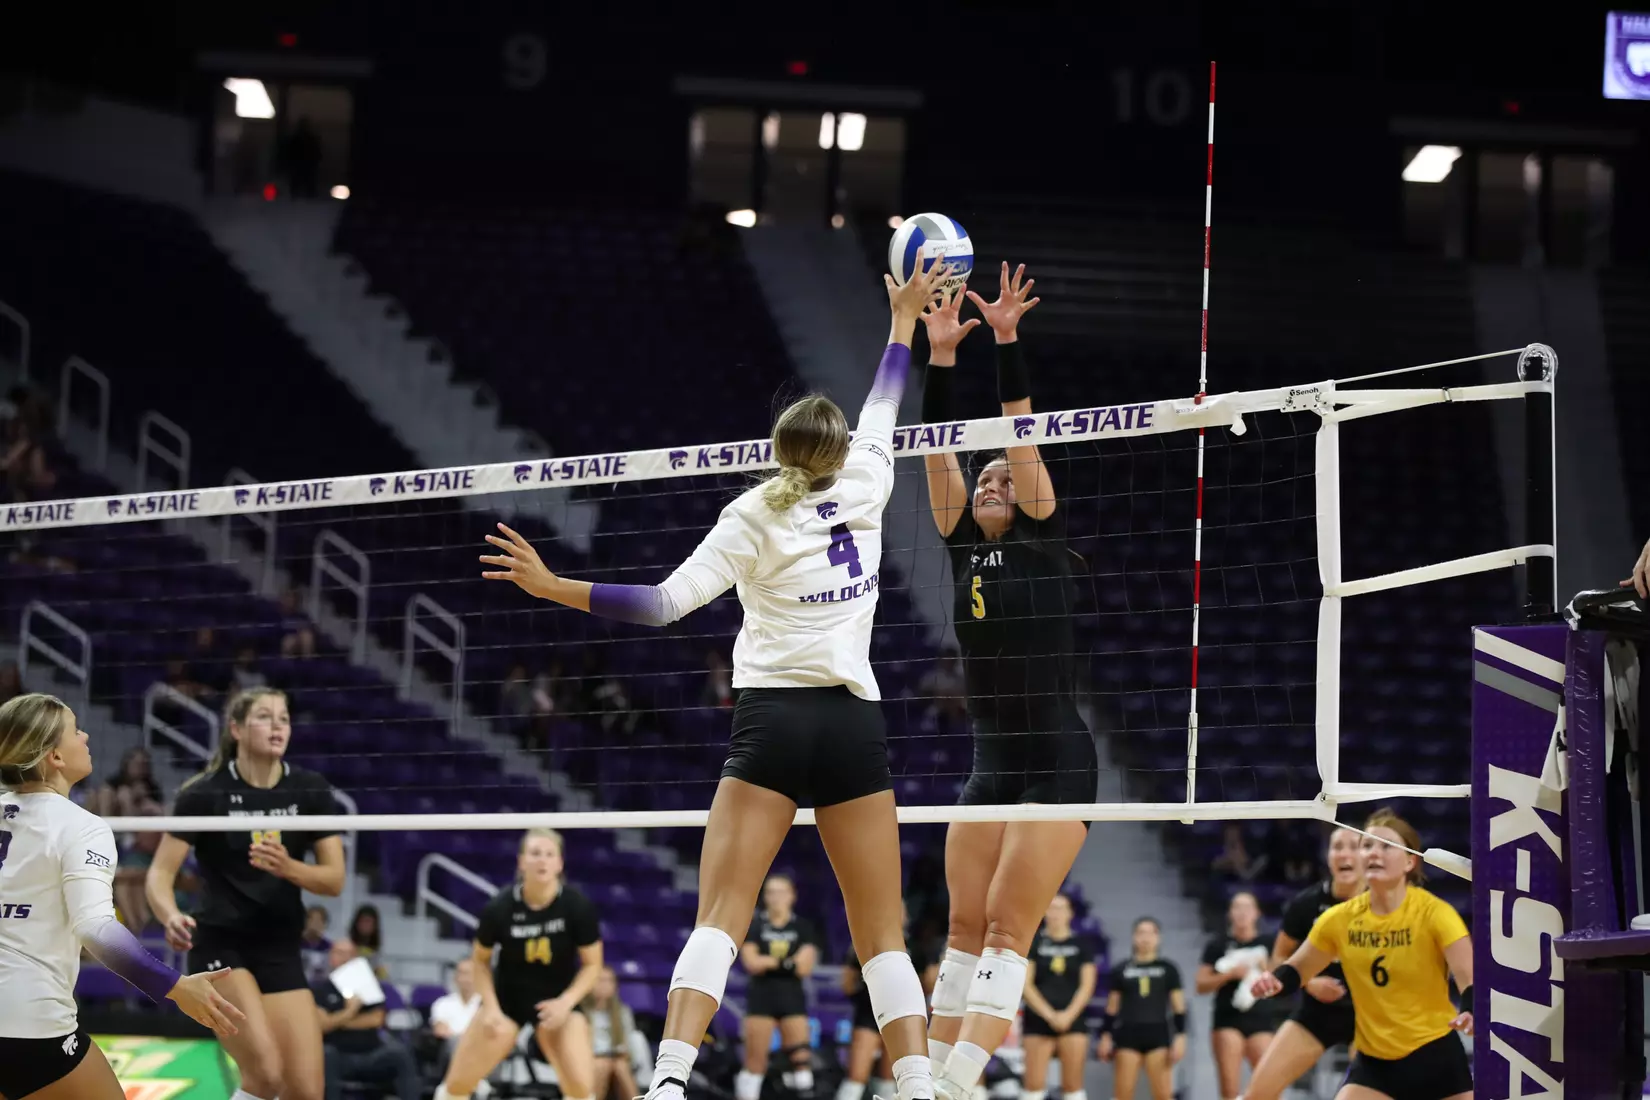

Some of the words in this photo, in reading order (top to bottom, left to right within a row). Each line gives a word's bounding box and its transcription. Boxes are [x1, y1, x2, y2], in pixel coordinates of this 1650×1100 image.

[502, 33, 547, 88] 9
[1109, 68, 1191, 126] 10
[1295, 387, 1319, 396] Senoh
[1045, 403, 1155, 438] K-STATE
[892, 423, 966, 451] STATE
[539, 455, 628, 482] K-STATE
[696, 442, 772, 468] K-STAT
[256, 481, 334, 506] K-STATE
[393, 469, 475, 494] K-STATE
[6, 502, 76, 525] K-STATE
[127, 492, 200, 515] K-STATE
[826, 521, 863, 579] 4
[971, 575, 986, 619] 5
[1370, 954, 1389, 987] 6
